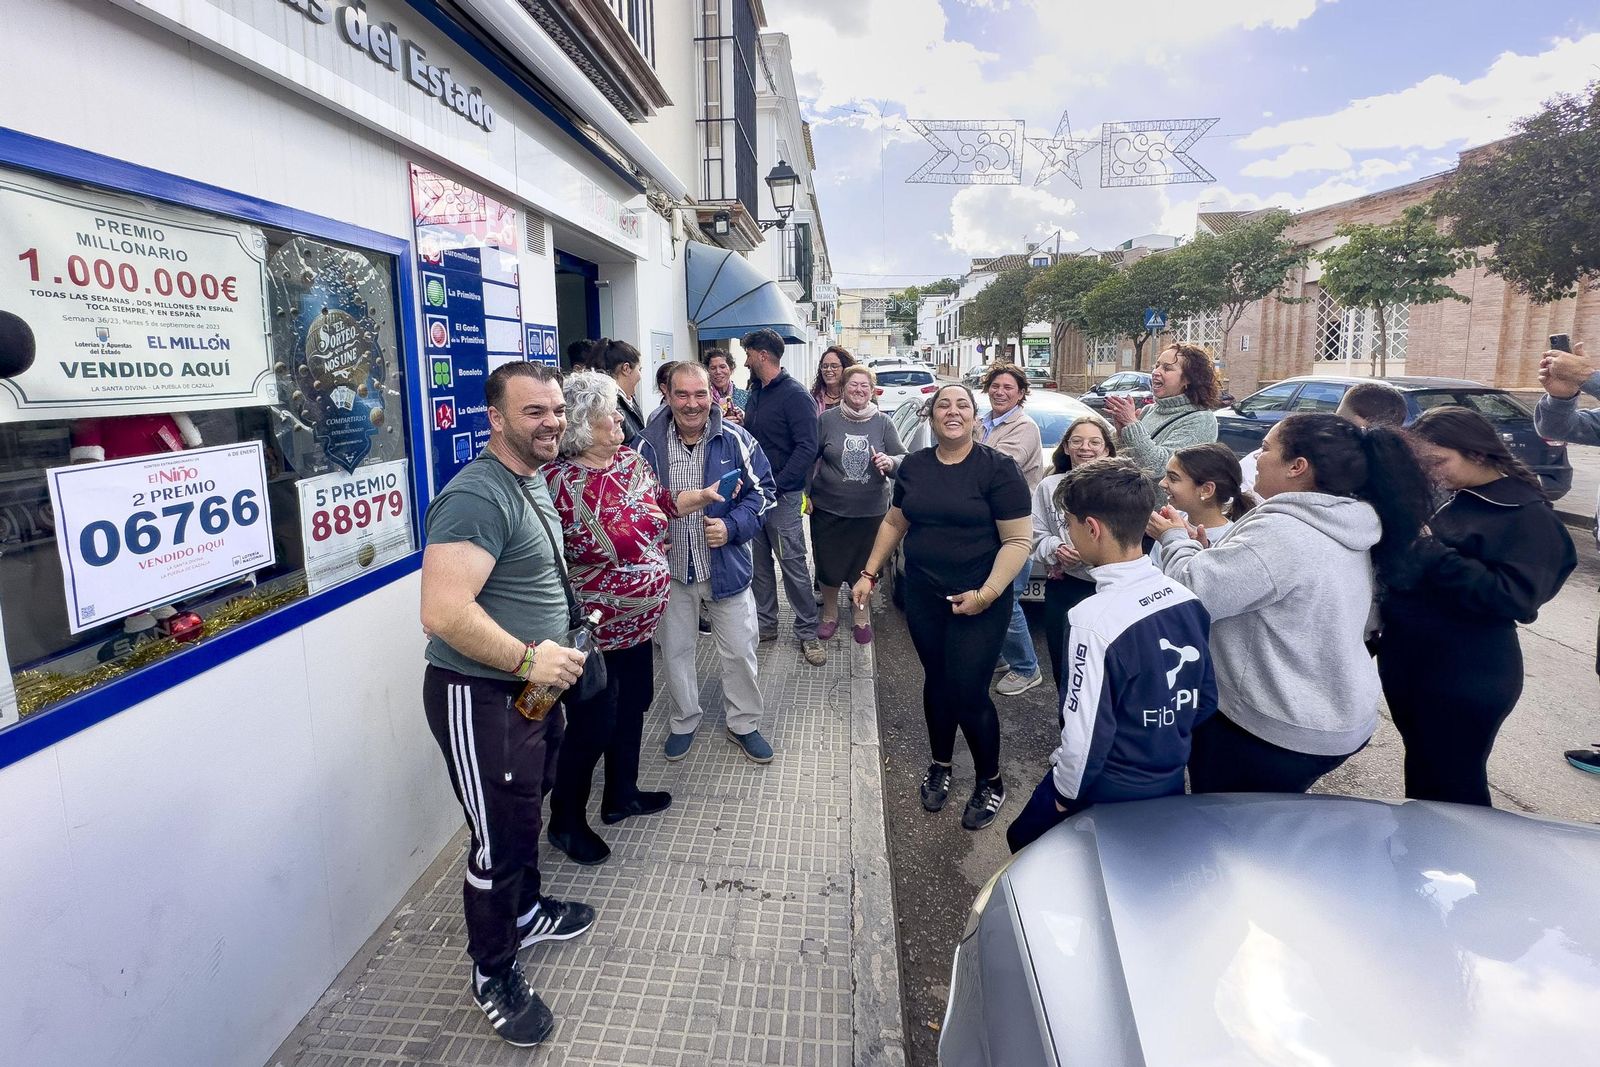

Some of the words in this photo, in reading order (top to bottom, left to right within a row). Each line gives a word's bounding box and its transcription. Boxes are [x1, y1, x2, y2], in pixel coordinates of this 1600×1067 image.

[343, 6, 402, 72] del
[408, 44, 496, 133] Estado
[95, 217, 165, 242] PREMIO
[76, 232, 188, 262] MILLONARIO
[19, 247, 238, 302] 1.000.000€
[30, 289, 66, 299] TODAS
[69, 293, 89, 301] LAS
[136, 299, 152, 307] DOS
[154, 301, 194, 310] MILLONES
[208, 304, 234, 313] ESPAÑA
[448, 288, 456, 297] La
[456, 289, 481, 301] Primitiva
[62, 314, 95, 323] Semana
[122, 318, 143, 326] Martes
[160, 321, 197, 329] septiembre
[86, 303, 110, 312] TOCA
[170, 310, 201, 318] ESPAÑA
[318, 324, 357, 353] SORTEO
[455, 323, 462, 331] El
[462, 324, 479, 333] Gordo
[107, 342, 132, 350] Apuestas
[147, 336, 167, 349] EL
[461, 336, 485, 345] Primitiva
[60, 361, 172, 379] VENDIDO
[181, 358, 231, 377] AQUÍ
[324, 356, 340, 373] NOS
[341, 347, 358, 366] UNE
[458, 368, 483, 376] Bonoloto
[239, 448, 257, 456] ENERO
[159, 464, 198, 485] Niño
[151, 479, 215, 503] PREMIO
[332, 473, 397, 502] PREMIO
[312, 490, 404, 542] 88979
[79, 489, 260, 567] 06766
[138, 547, 194, 570] VENDIDO
[1023, 582, 1046, 596] 98
[1138, 587, 1173, 607] GIVOVA
[1068, 643, 1087, 713] GIVOVA
